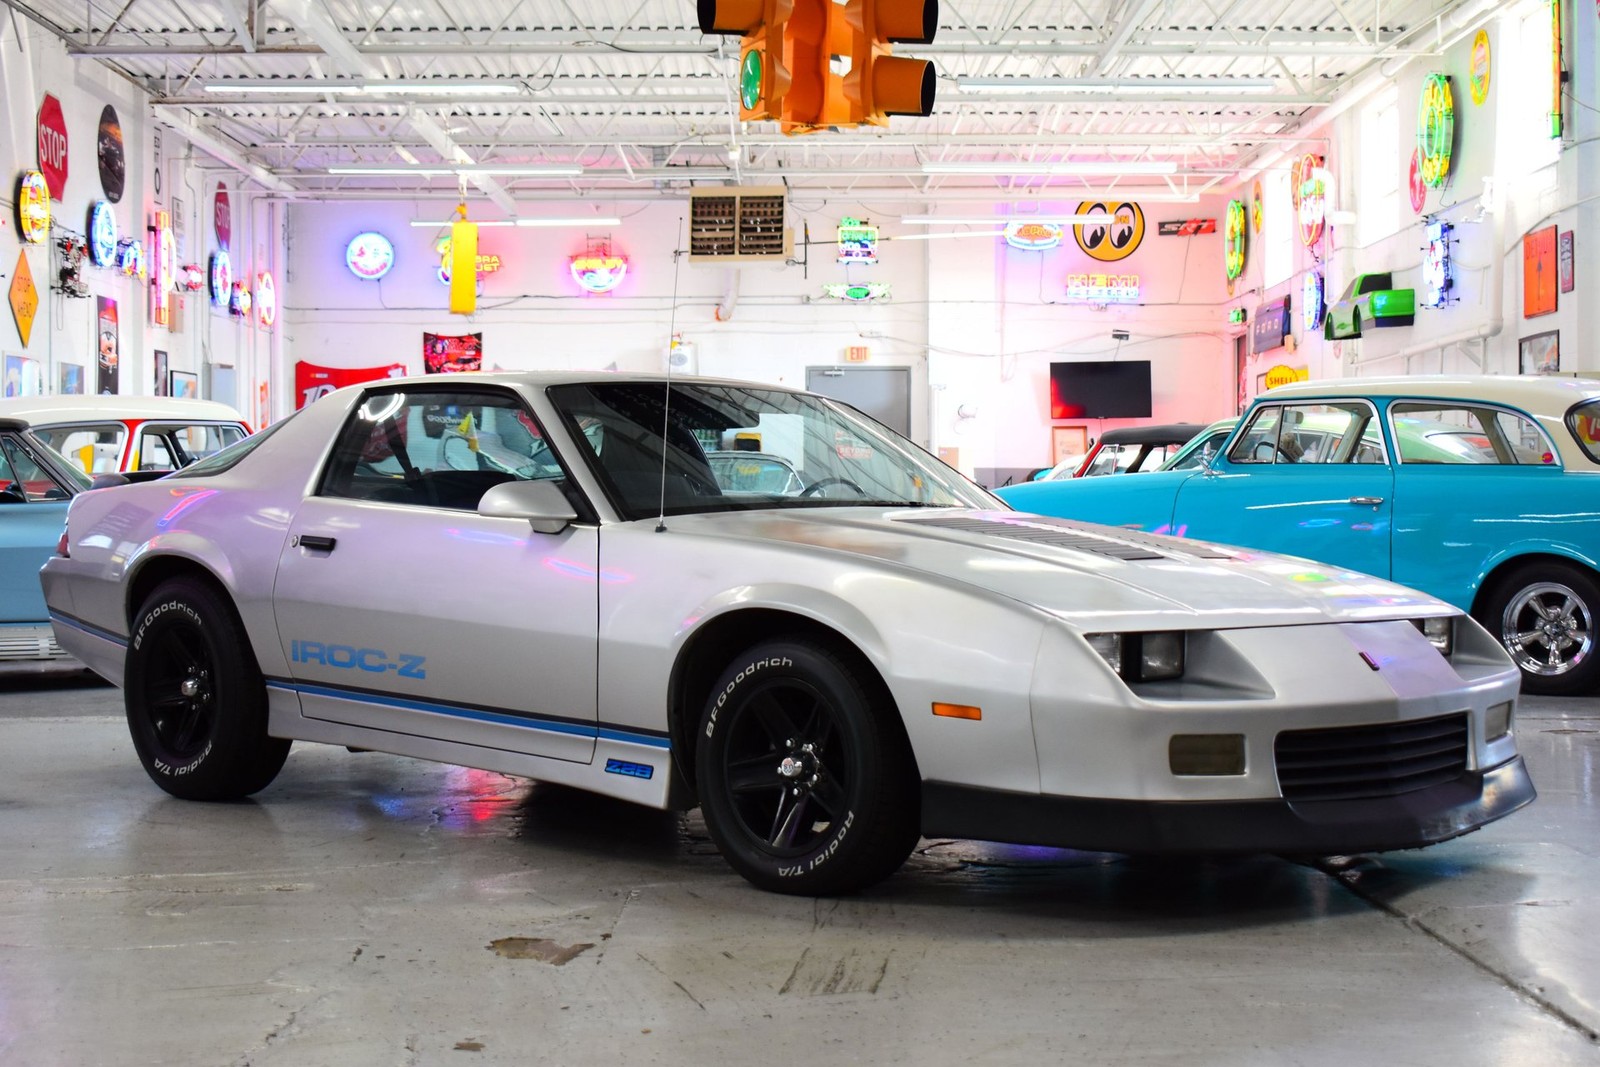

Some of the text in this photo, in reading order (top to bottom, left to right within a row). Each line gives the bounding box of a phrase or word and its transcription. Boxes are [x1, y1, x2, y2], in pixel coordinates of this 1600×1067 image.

[40, 124, 67, 171] STOP
[1160, 221, 1216, 233] SRT
[1067, 274, 1139, 288] HEMI
[1256, 318, 1279, 335] FORD
[850, 347, 868, 361] EXIT
[133, 600, 203, 650] BFGoodrich
[291, 639, 427, 680] IROC-Z
[705, 656, 793, 738] BFGoodrich
[154, 757, 172, 776] T/A
[778, 866, 804, 877] T/A
